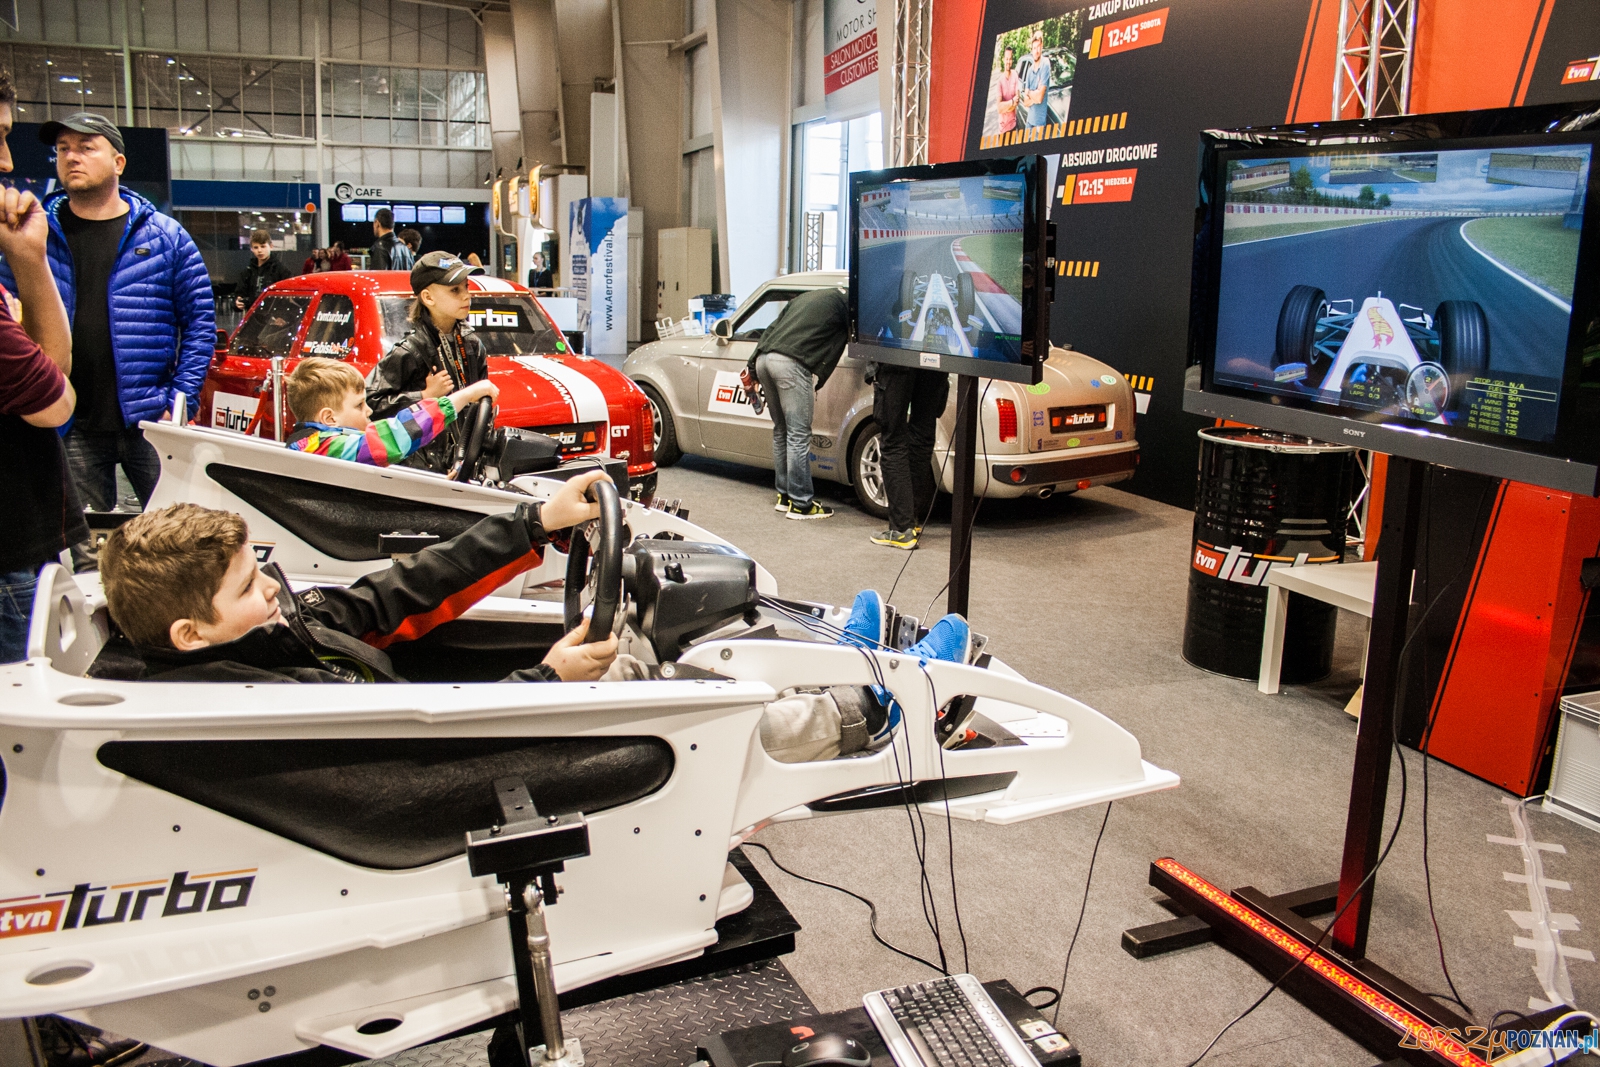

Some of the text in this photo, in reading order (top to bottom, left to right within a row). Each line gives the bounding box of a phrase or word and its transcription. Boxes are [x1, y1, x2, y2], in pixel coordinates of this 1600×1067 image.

[1088, 0, 1121, 20] ZAKUP
[836, 14, 864, 43] MOTOR
[1108, 18, 1161, 48] 12:45 SOBOTA
[830, 46, 850, 69] SALON
[840, 61, 868, 85] CUSTOM
[1567, 67, 1590, 79] tvn
[1062, 143, 1158, 168] ABSURDY DROGOWE
[355, 188, 382, 196] CAFE
[1078, 176, 1132, 196] 12:15 NIEDZIELA
[604, 226, 615, 332] www.Aerofestival.pl
[1480, 404, 1502, 413] PRESS
[1484, 398, 1502, 406] WING
[1072, 412, 1095, 424] turbo
[1478, 418, 1500, 426] PRESS
[1480, 411, 1501, 420] PRESS
[611, 425, 630, 438] GT
[1343, 428, 1366, 438] SONY
[1478, 424, 1499, 432] PRESS
[1195, 550, 1217, 570] tvn
[0, 870, 256, 932] tvn turbo
